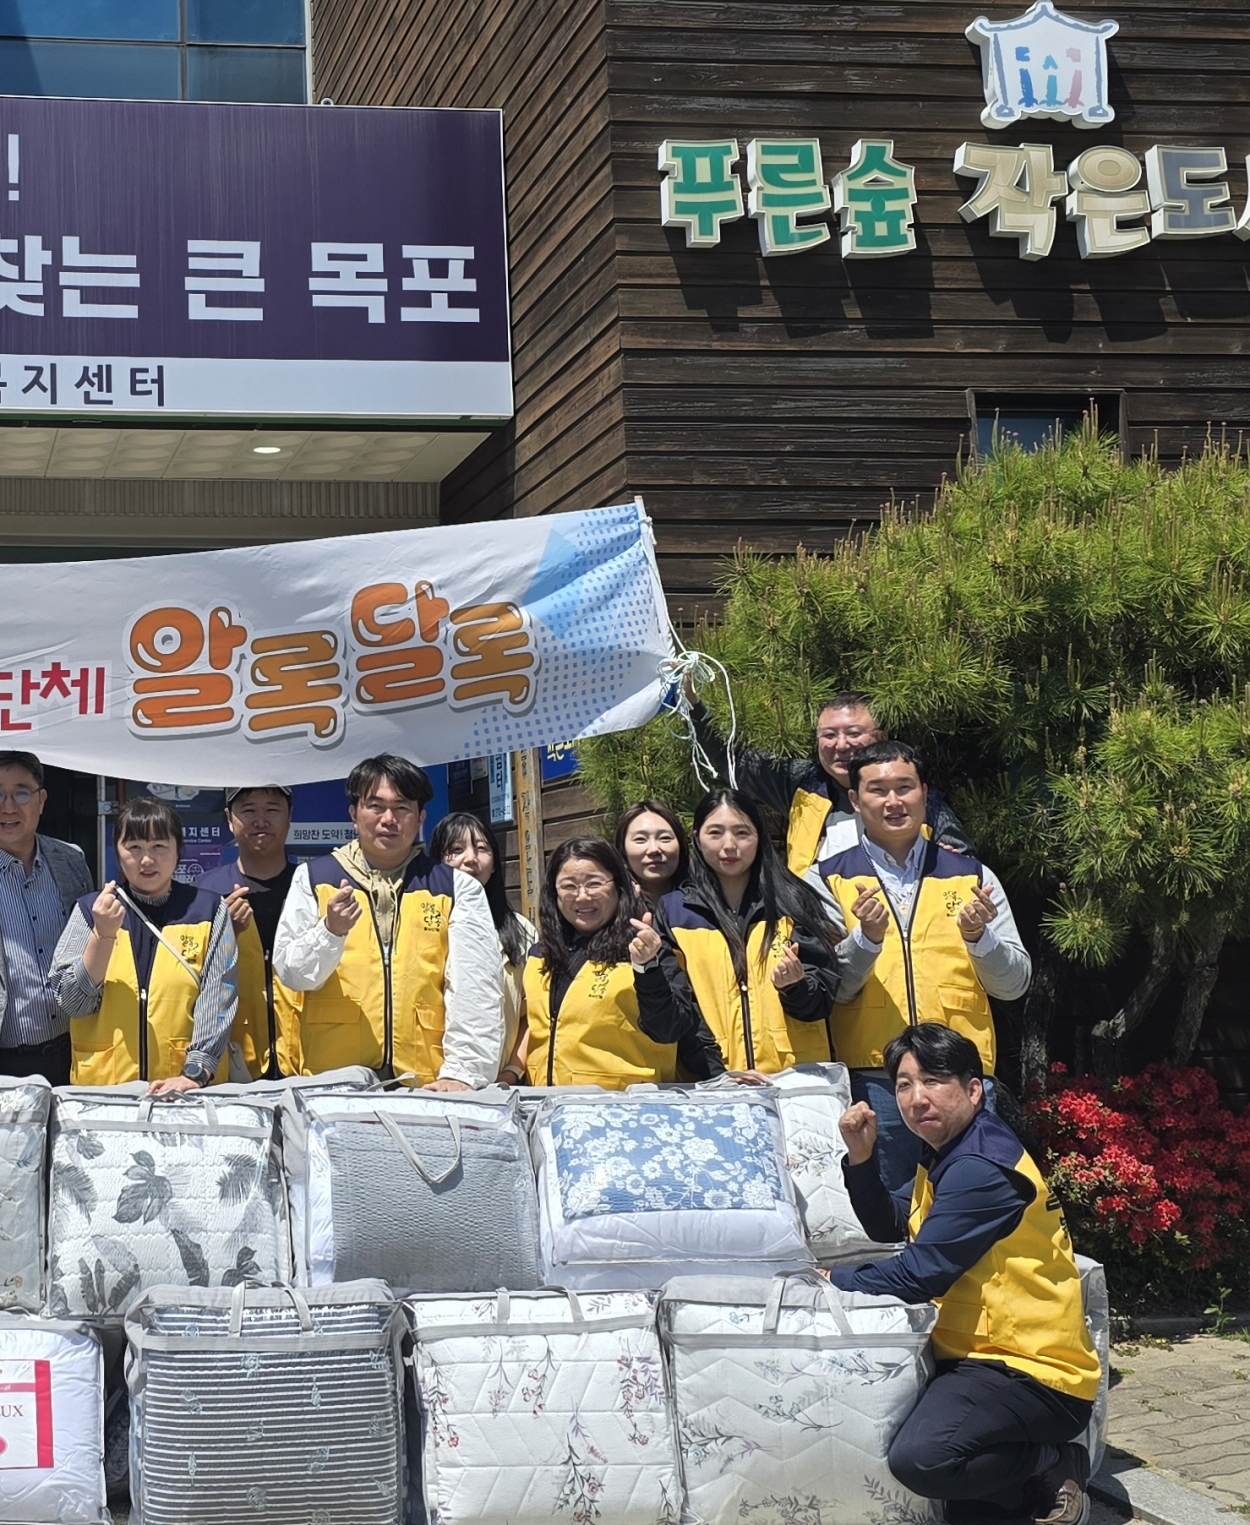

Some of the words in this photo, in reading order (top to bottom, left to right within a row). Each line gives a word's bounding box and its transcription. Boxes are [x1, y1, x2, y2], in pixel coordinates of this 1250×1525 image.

[658, 137, 918, 260] 푸른숲
[953, 141, 1250, 262] 작은도
[184, 239, 266, 321] 큰
[308, 241, 481, 324] 목포
[128, 578, 537, 740] 알록달록
[293, 829, 320, 840] 희망찬
